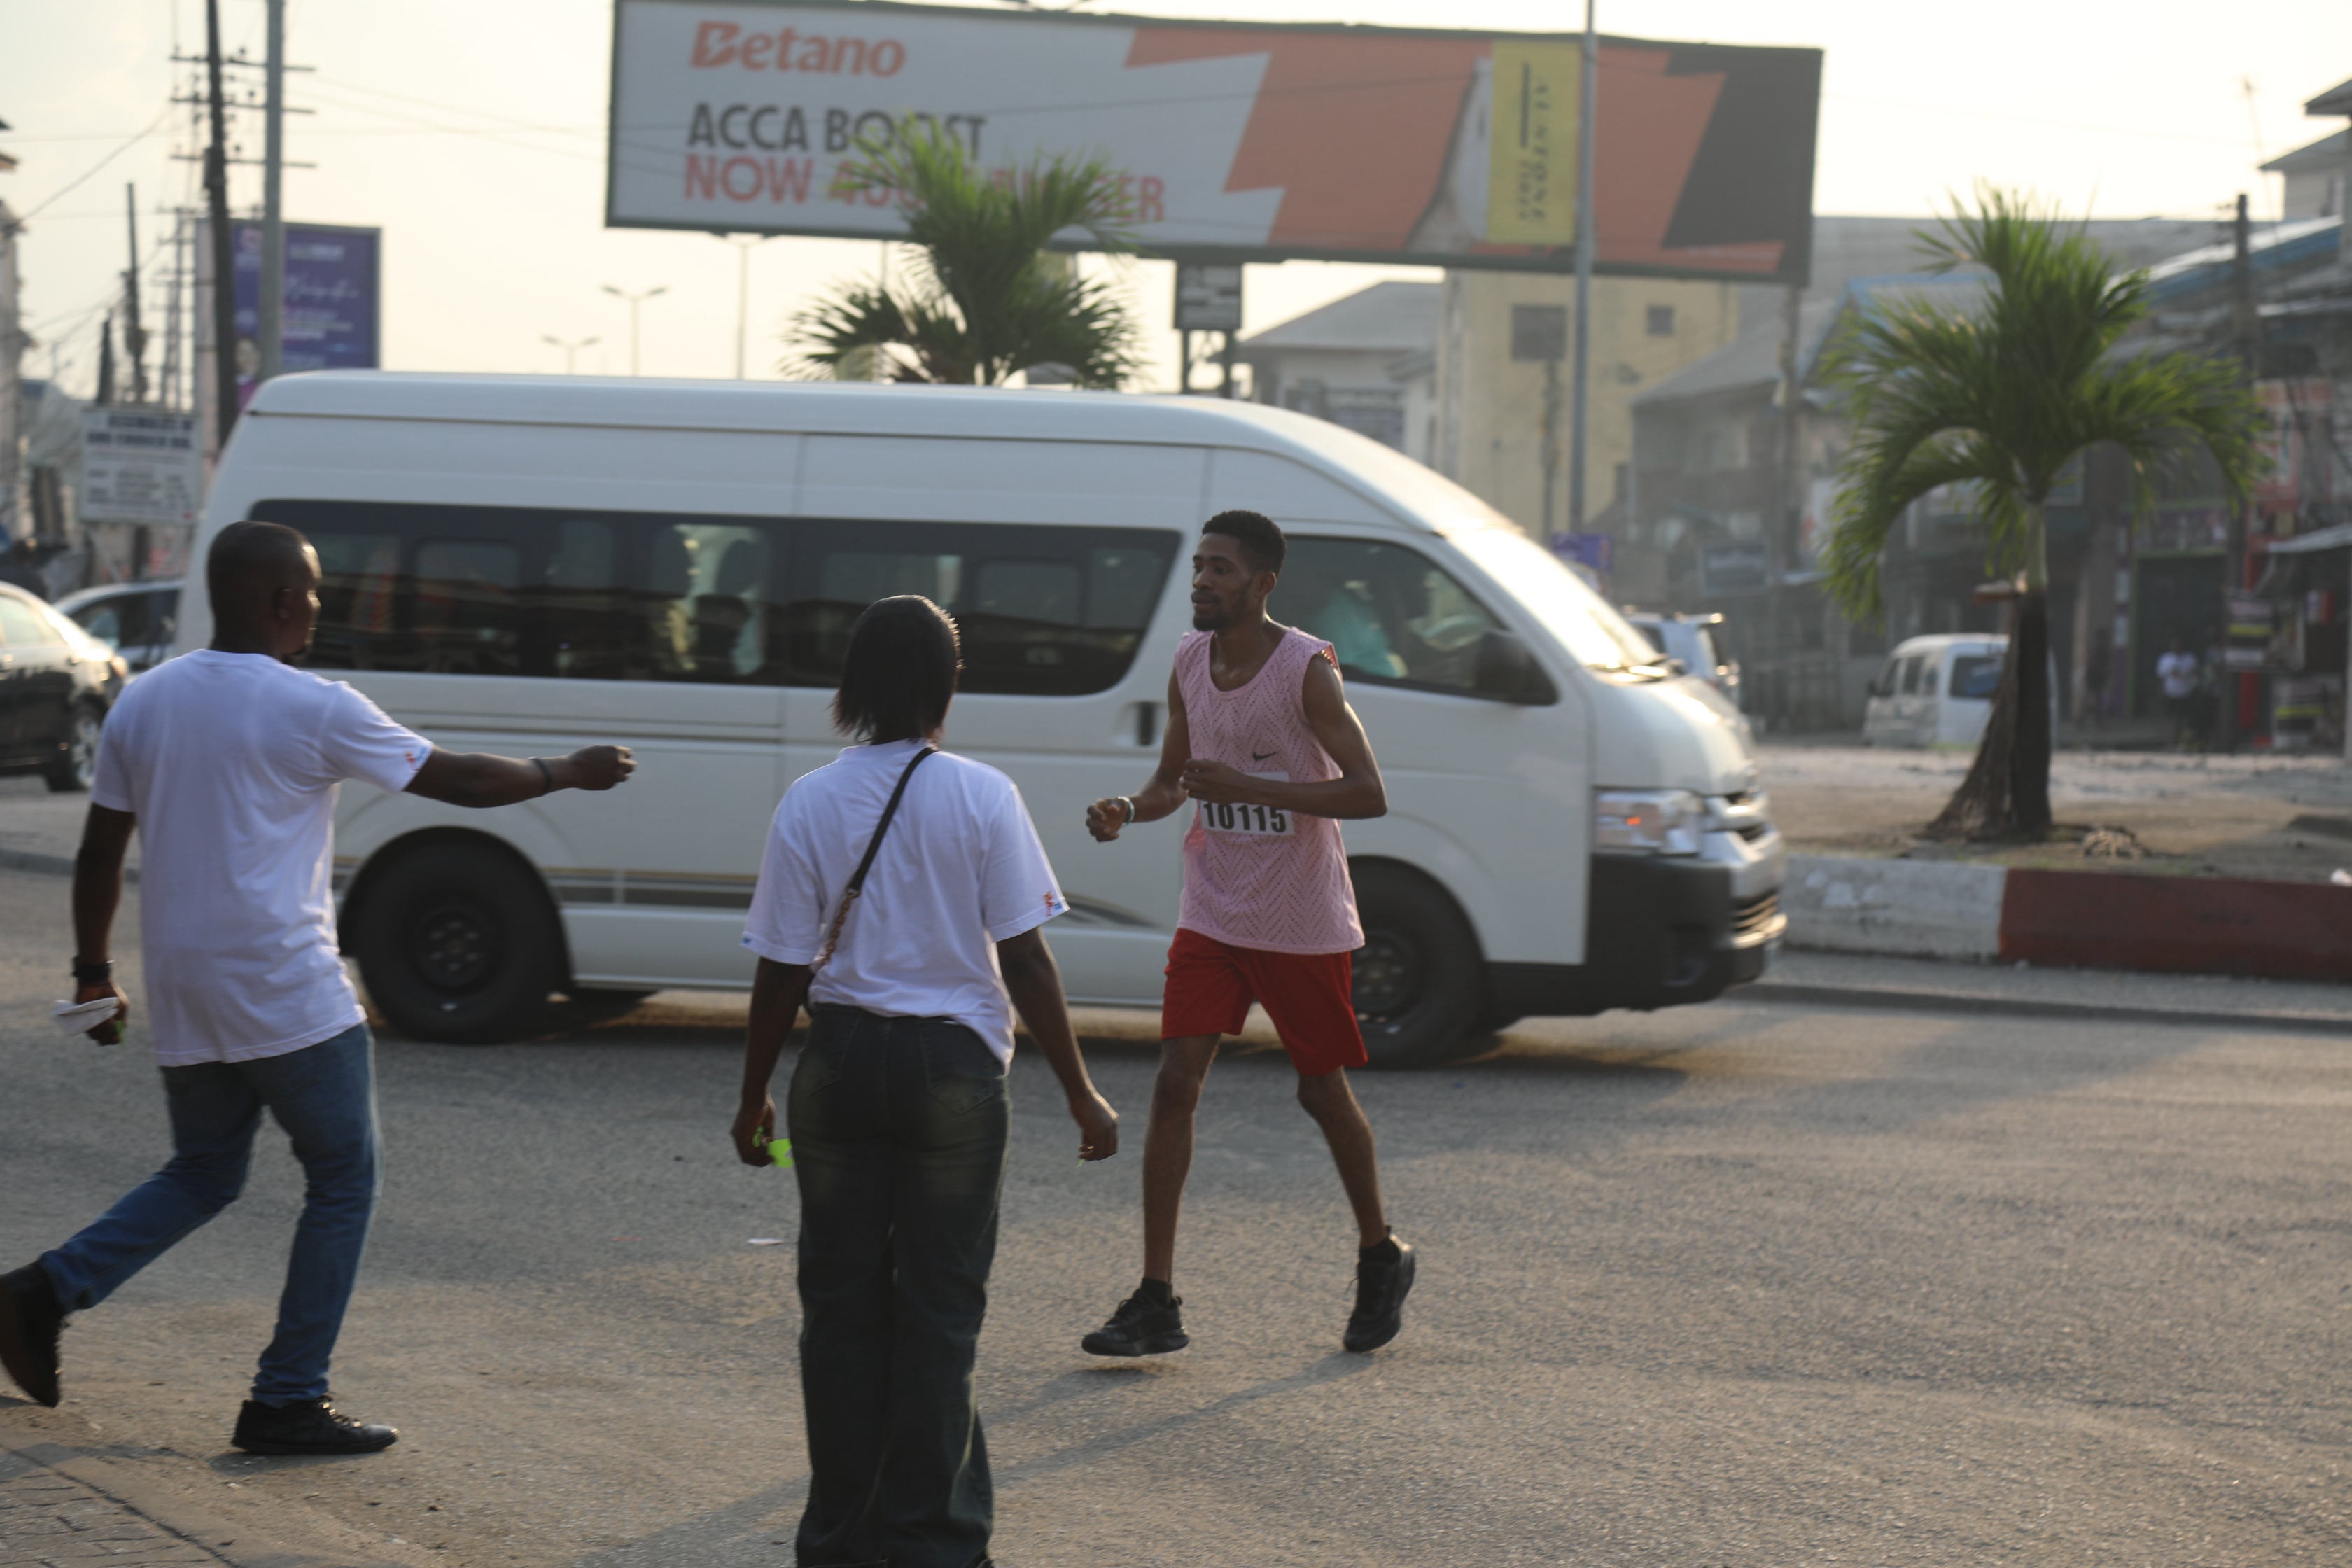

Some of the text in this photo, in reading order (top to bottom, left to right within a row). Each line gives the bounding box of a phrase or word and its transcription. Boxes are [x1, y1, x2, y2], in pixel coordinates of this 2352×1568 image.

[691, 21, 907, 77] Betano
[687, 102, 810, 152] ACCA
[684, 153, 815, 203] NOW
[1203, 802, 1287, 833] 10115
